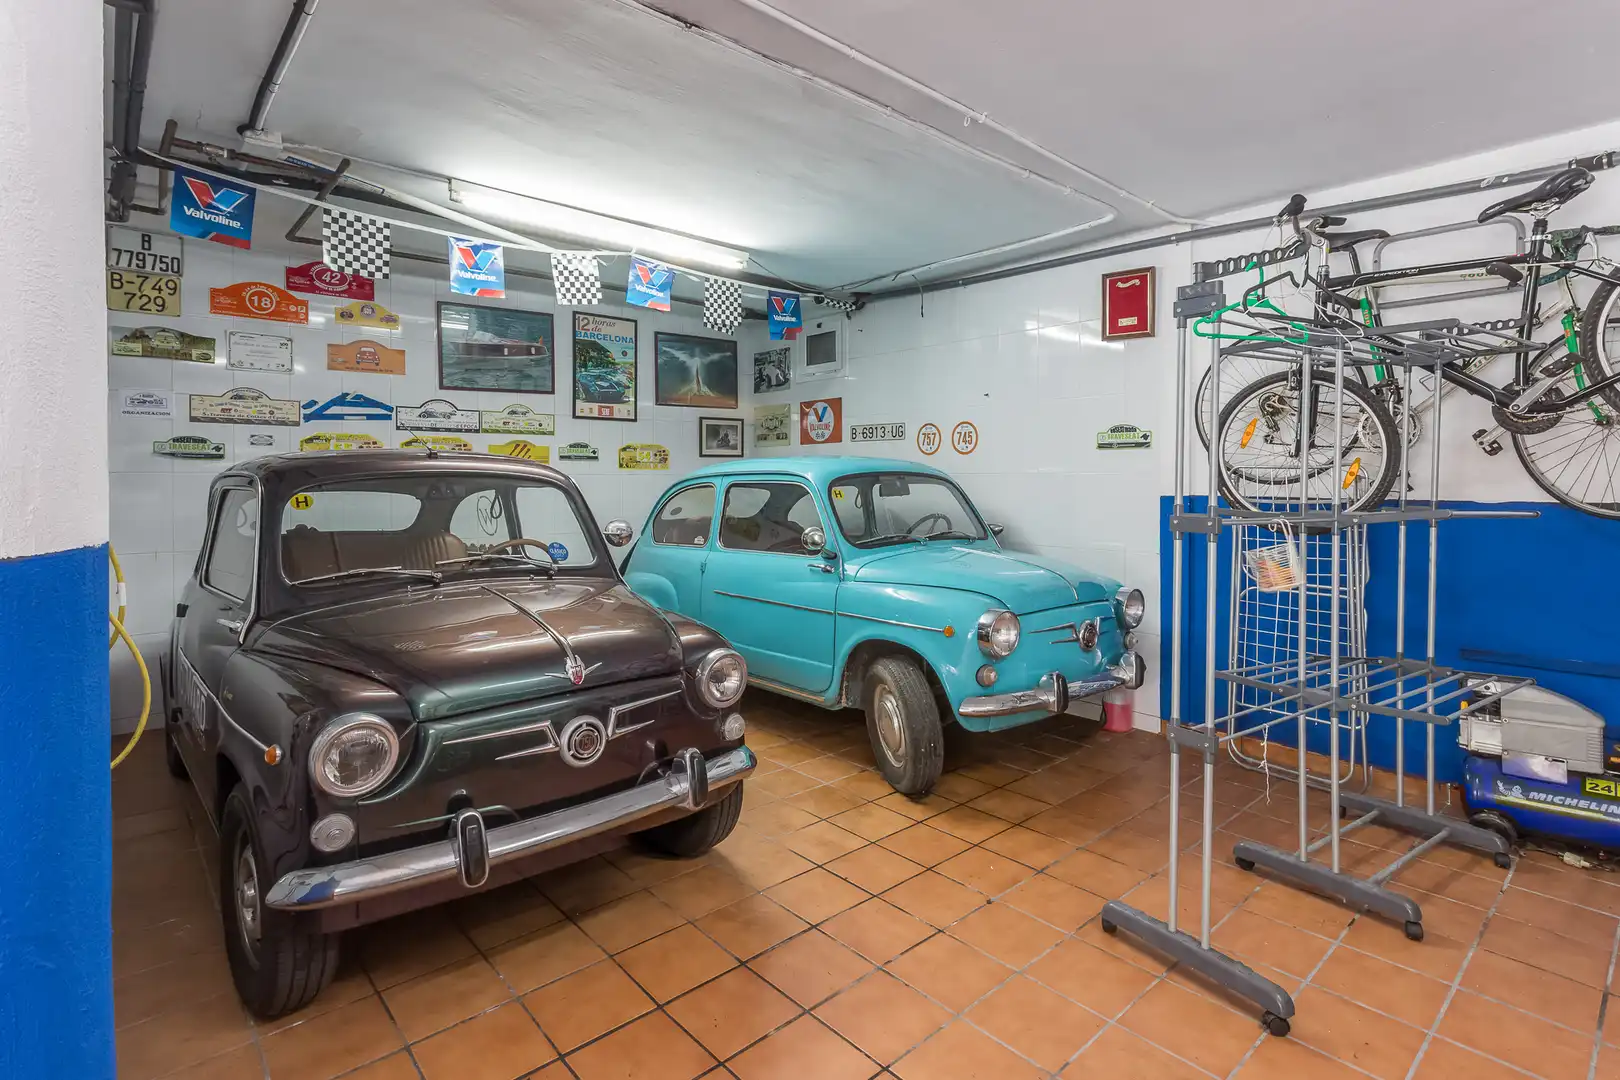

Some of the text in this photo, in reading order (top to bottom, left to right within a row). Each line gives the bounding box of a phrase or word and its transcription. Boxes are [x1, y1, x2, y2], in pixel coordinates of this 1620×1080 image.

[183, 205, 241, 229] Valvoline
[141, 233, 152, 251] B
[111, 248, 181, 274] 779750
[322, 271, 341, 284] 42
[457, 269, 497, 281] Valvoline
[110, 271, 178, 296] B-749
[634, 283, 665, 298] Valvoline
[124, 291, 166, 313] 729
[251, 295, 272, 308] 18
[576, 316, 616, 332] 12 horas
[591, 325, 602, 333] de
[575, 330, 634, 344] BARCELONA
[921, 432, 936, 446] 757
[957, 431, 973, 445] 745
[168, 442, 211, 451] TRAVESEAT
[834, 490, 843, 498] H
[295, 495, 309, 508] H
[1587, 782, 1614, 794] 24
[1528, 791, 1620, 814] MICHELIN
